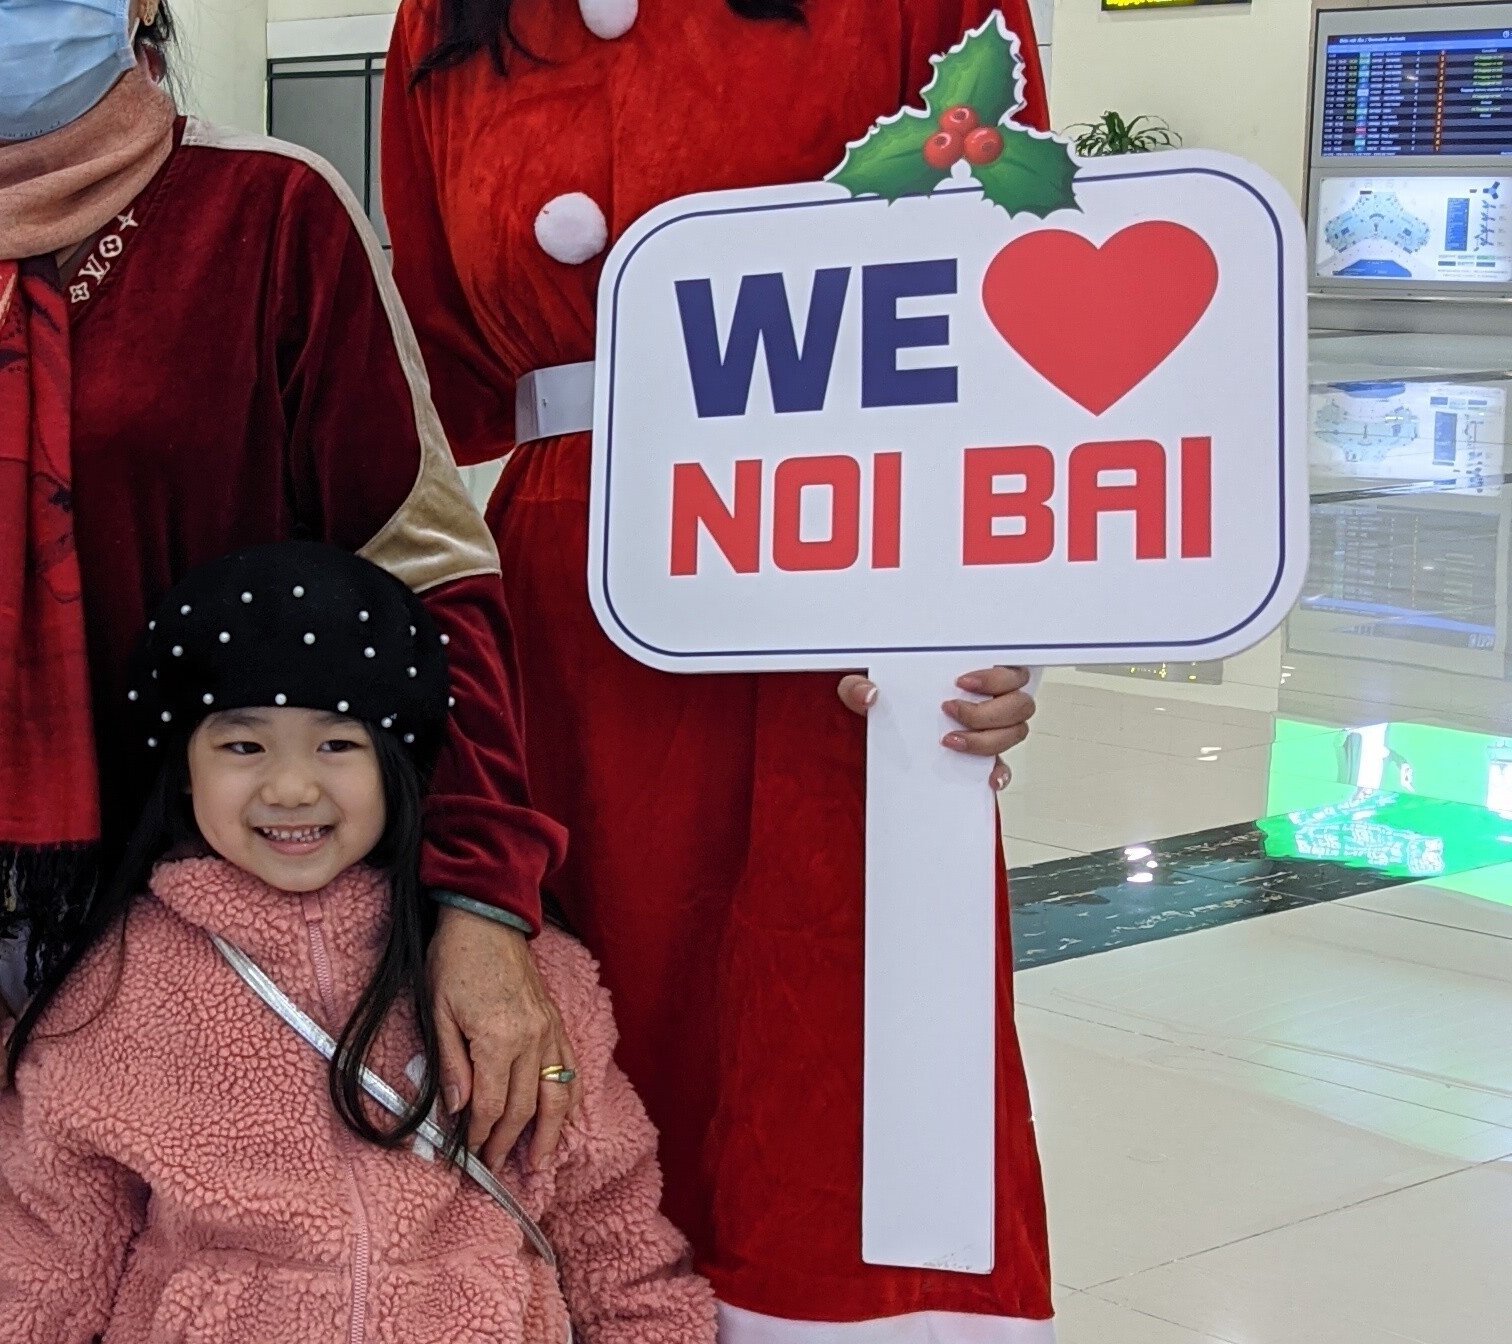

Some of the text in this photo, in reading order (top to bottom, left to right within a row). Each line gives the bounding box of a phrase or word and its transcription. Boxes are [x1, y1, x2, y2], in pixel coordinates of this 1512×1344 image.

[675, 258, 959, 418] WE
[670, 436, 1212, 576] NOI BAI
